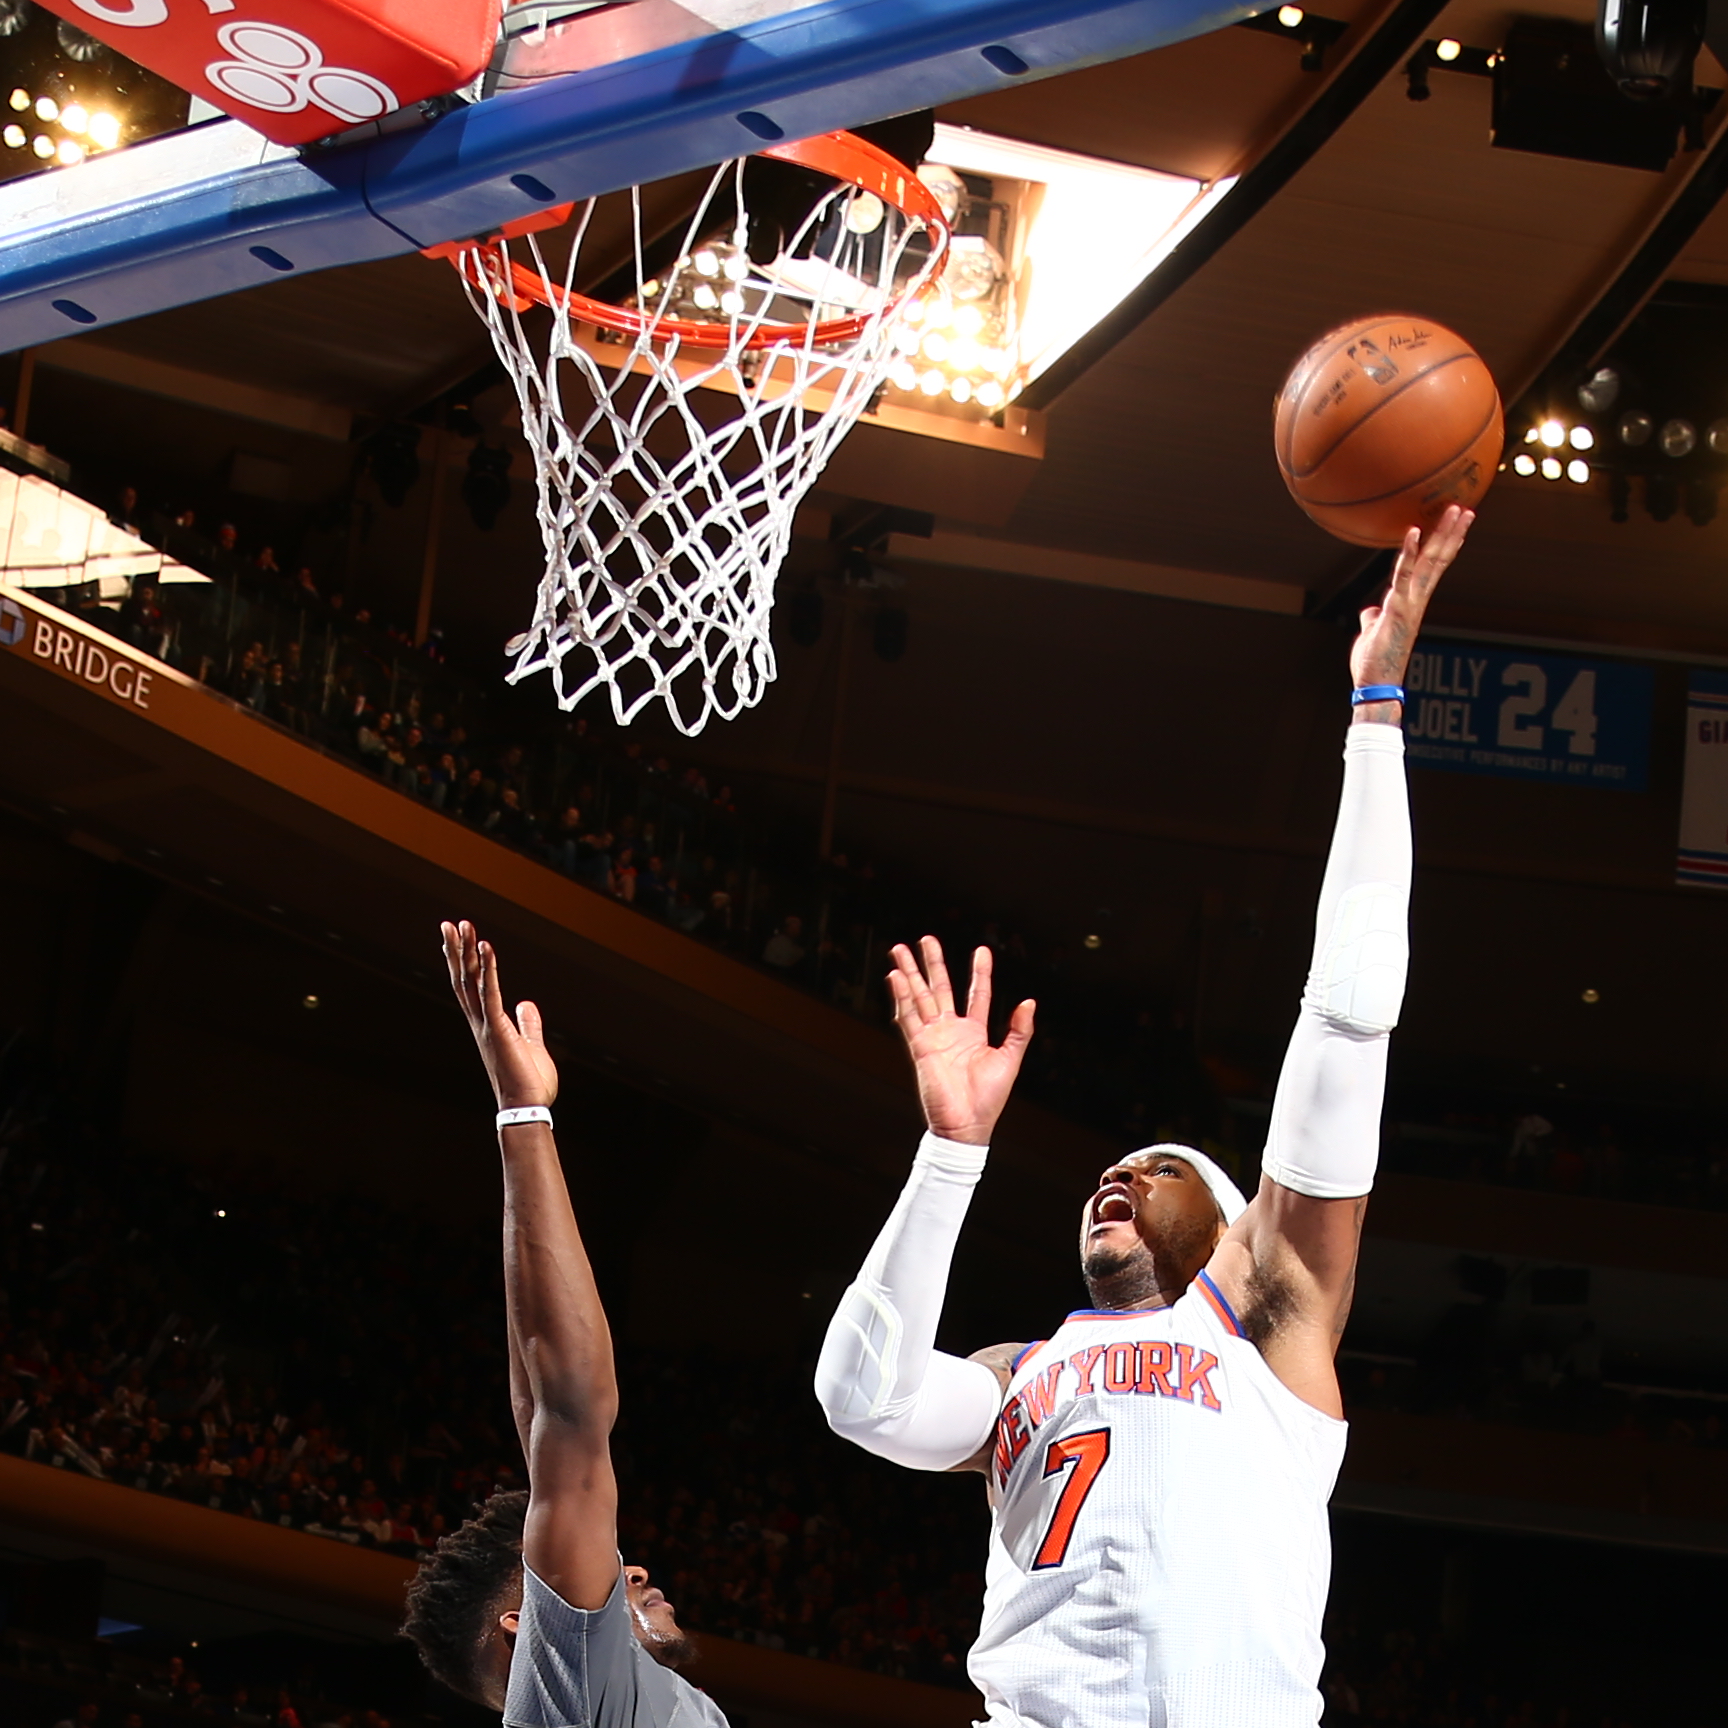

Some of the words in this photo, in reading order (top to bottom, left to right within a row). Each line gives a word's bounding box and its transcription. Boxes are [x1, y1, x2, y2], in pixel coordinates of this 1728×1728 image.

[33, 620, 153, 709] BRIDGE
[1408, 651, 1489, 698] BILLY
[1497, 662, 1599, 757] 24
[1408, 698, 1479, 744] JOEL
[995, 1360, 1064, 1493] NEW
[1069, 1340, 1223, 1415] YORK
[1031, 1426, 1112, 1572] 7
